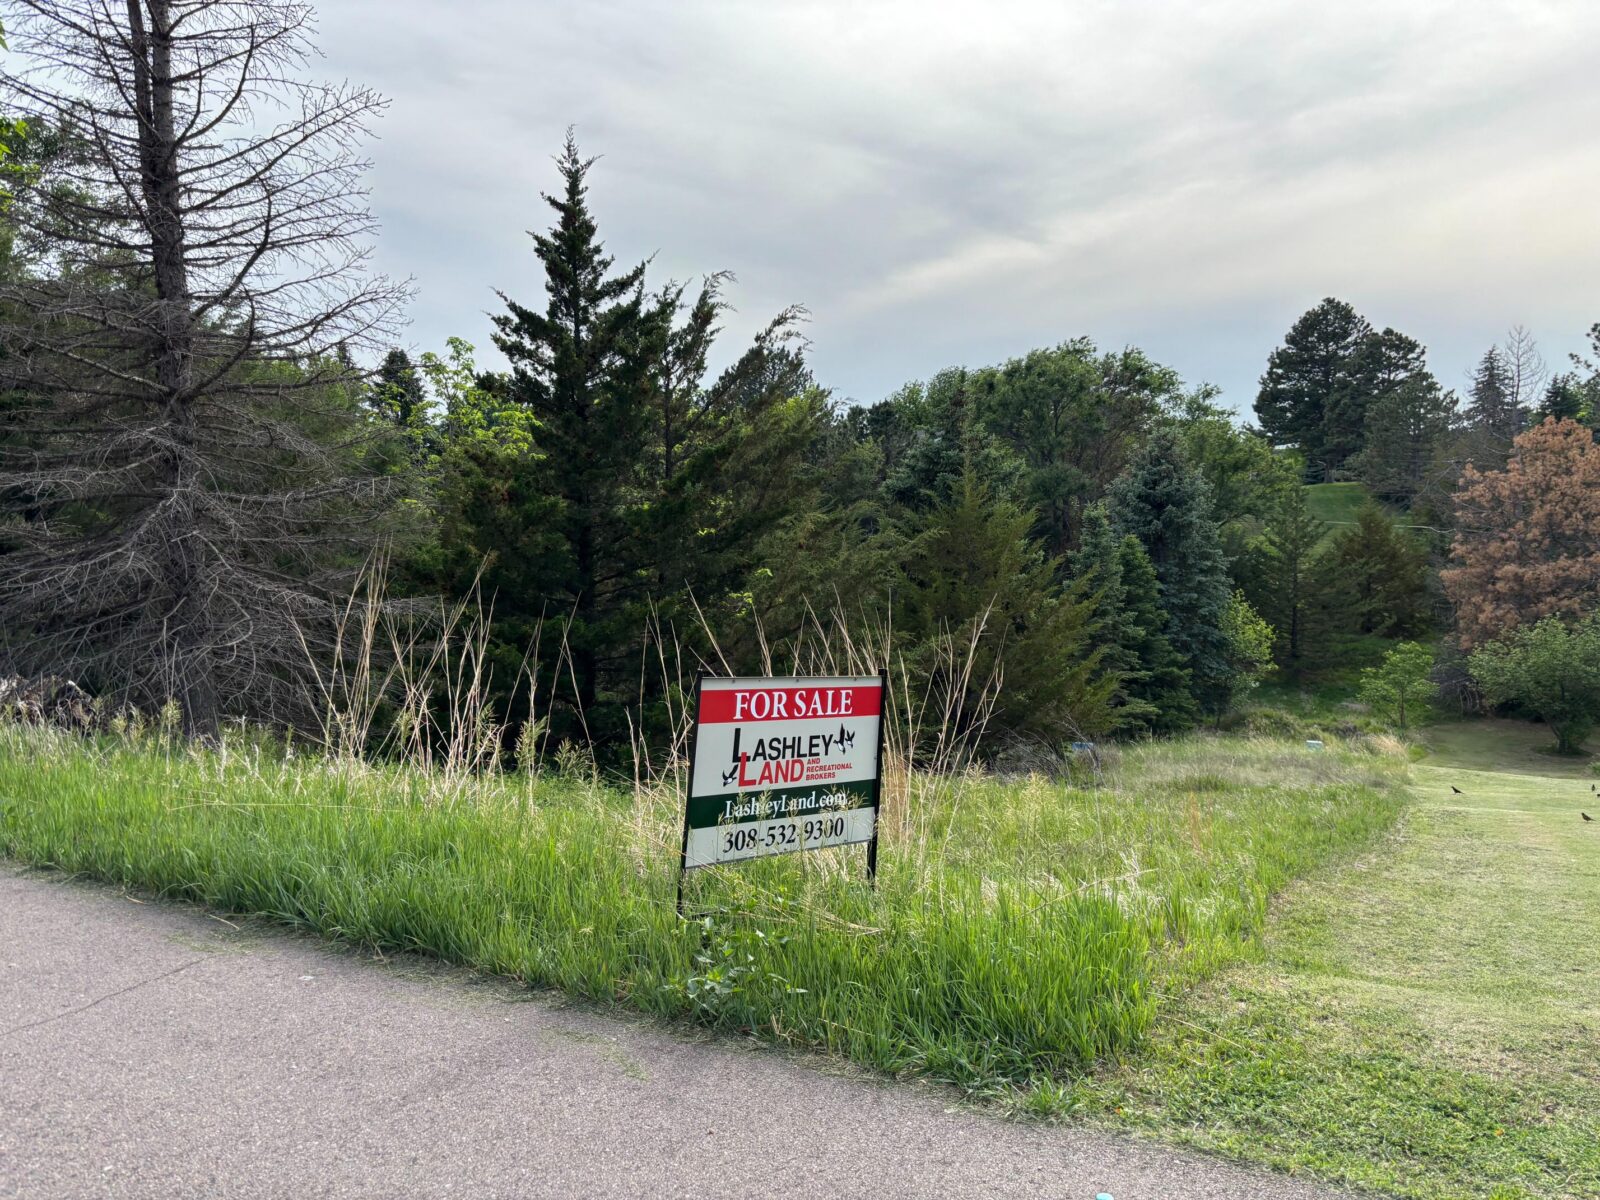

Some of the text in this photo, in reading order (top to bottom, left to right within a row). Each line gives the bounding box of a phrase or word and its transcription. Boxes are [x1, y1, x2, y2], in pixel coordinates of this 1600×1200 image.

[733, 689, 853, 720] FOR SALE
[732, 728, 834, 763] LASHLEY
[738, 752, 805, 787] LAND
[805, 772, 836, 781] BROKERS
[806, 763, 853, 772] RECREATIONAL
[724, 791, 847, 819] LasheyLand.com
